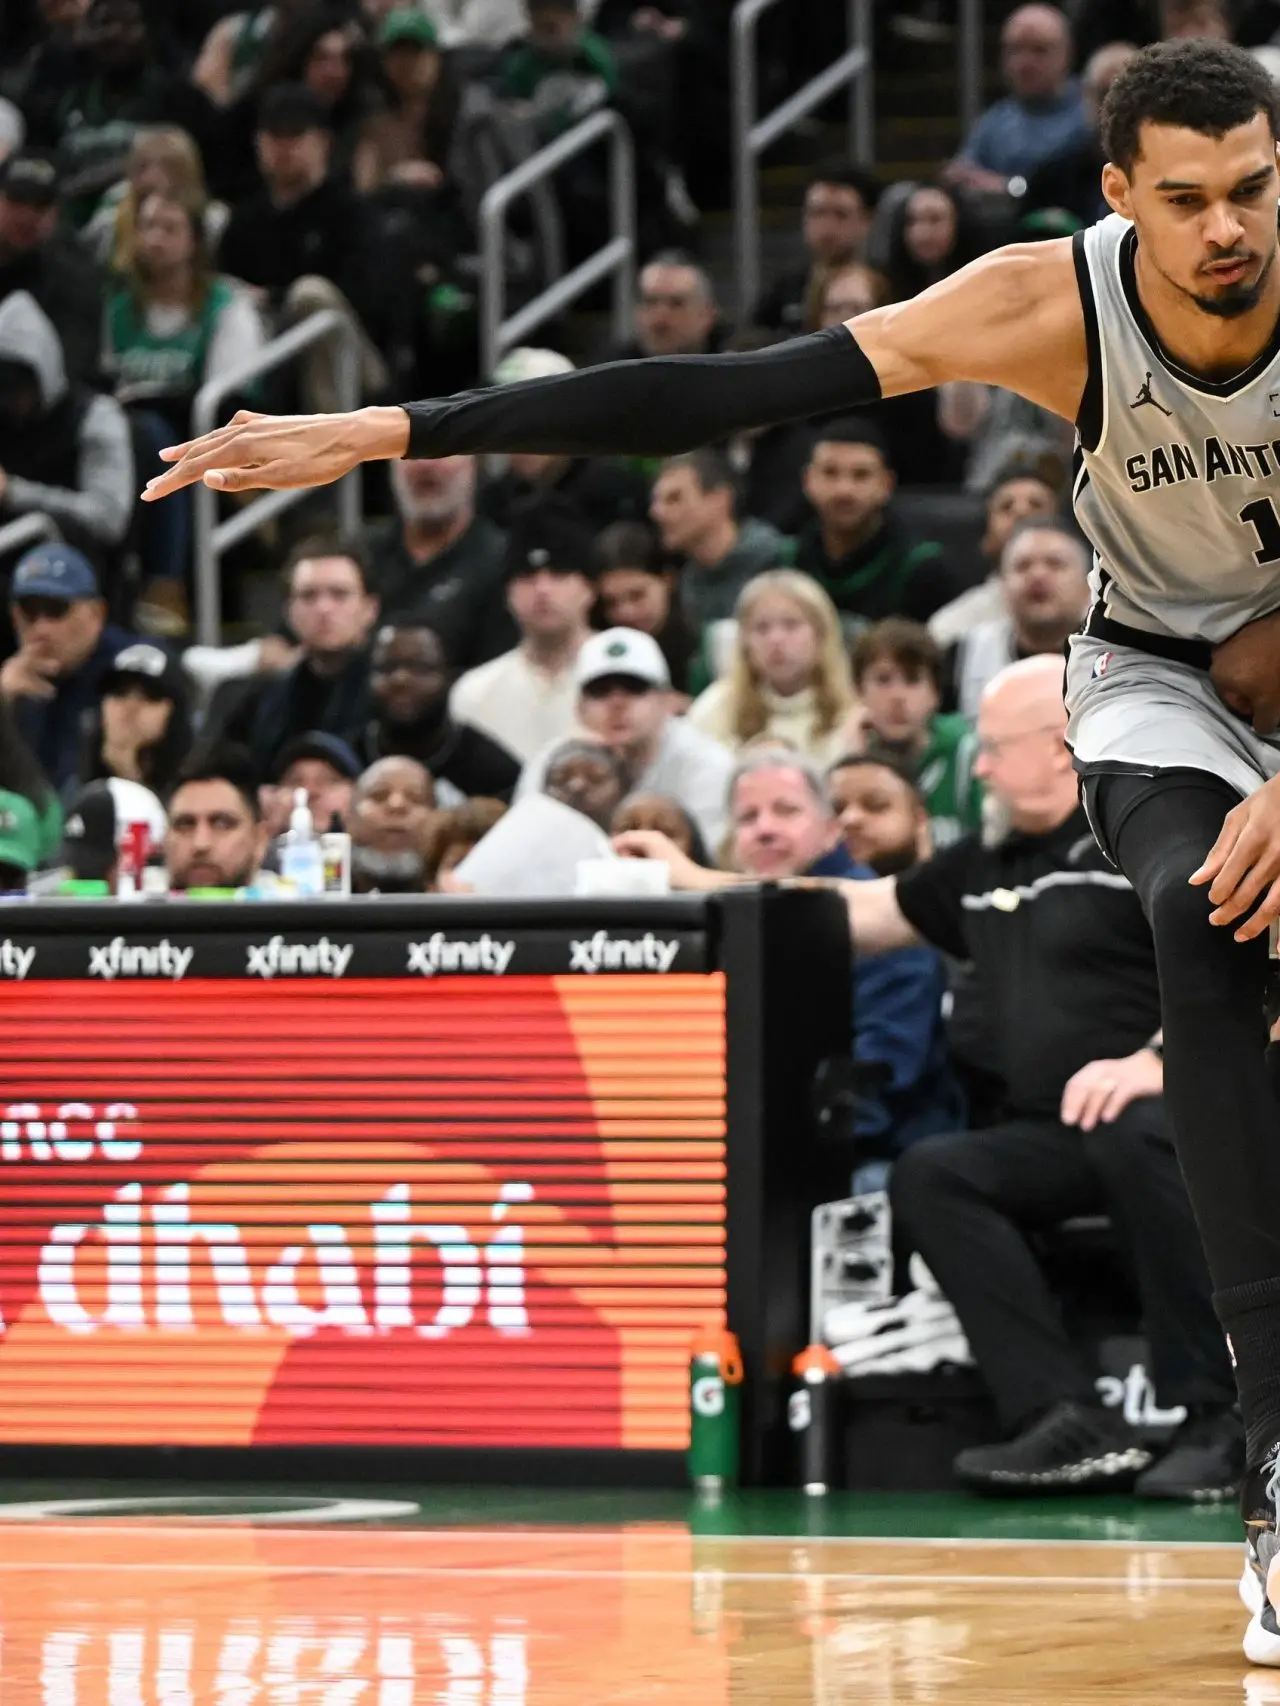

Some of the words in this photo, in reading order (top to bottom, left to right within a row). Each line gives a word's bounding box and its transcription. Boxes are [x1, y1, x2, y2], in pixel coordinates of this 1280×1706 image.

[1125, 442, 1201, 494] SAN
[88, 935, 195, 981] xfinity
[246, 934, 354, 980] xfinity
[406, 931, 516, 977] xfinity
[569, 929, 681, 975] xfinity
[37, 1182, 535, 1338] dhabi
[692, 1376, 725, 1417] G
